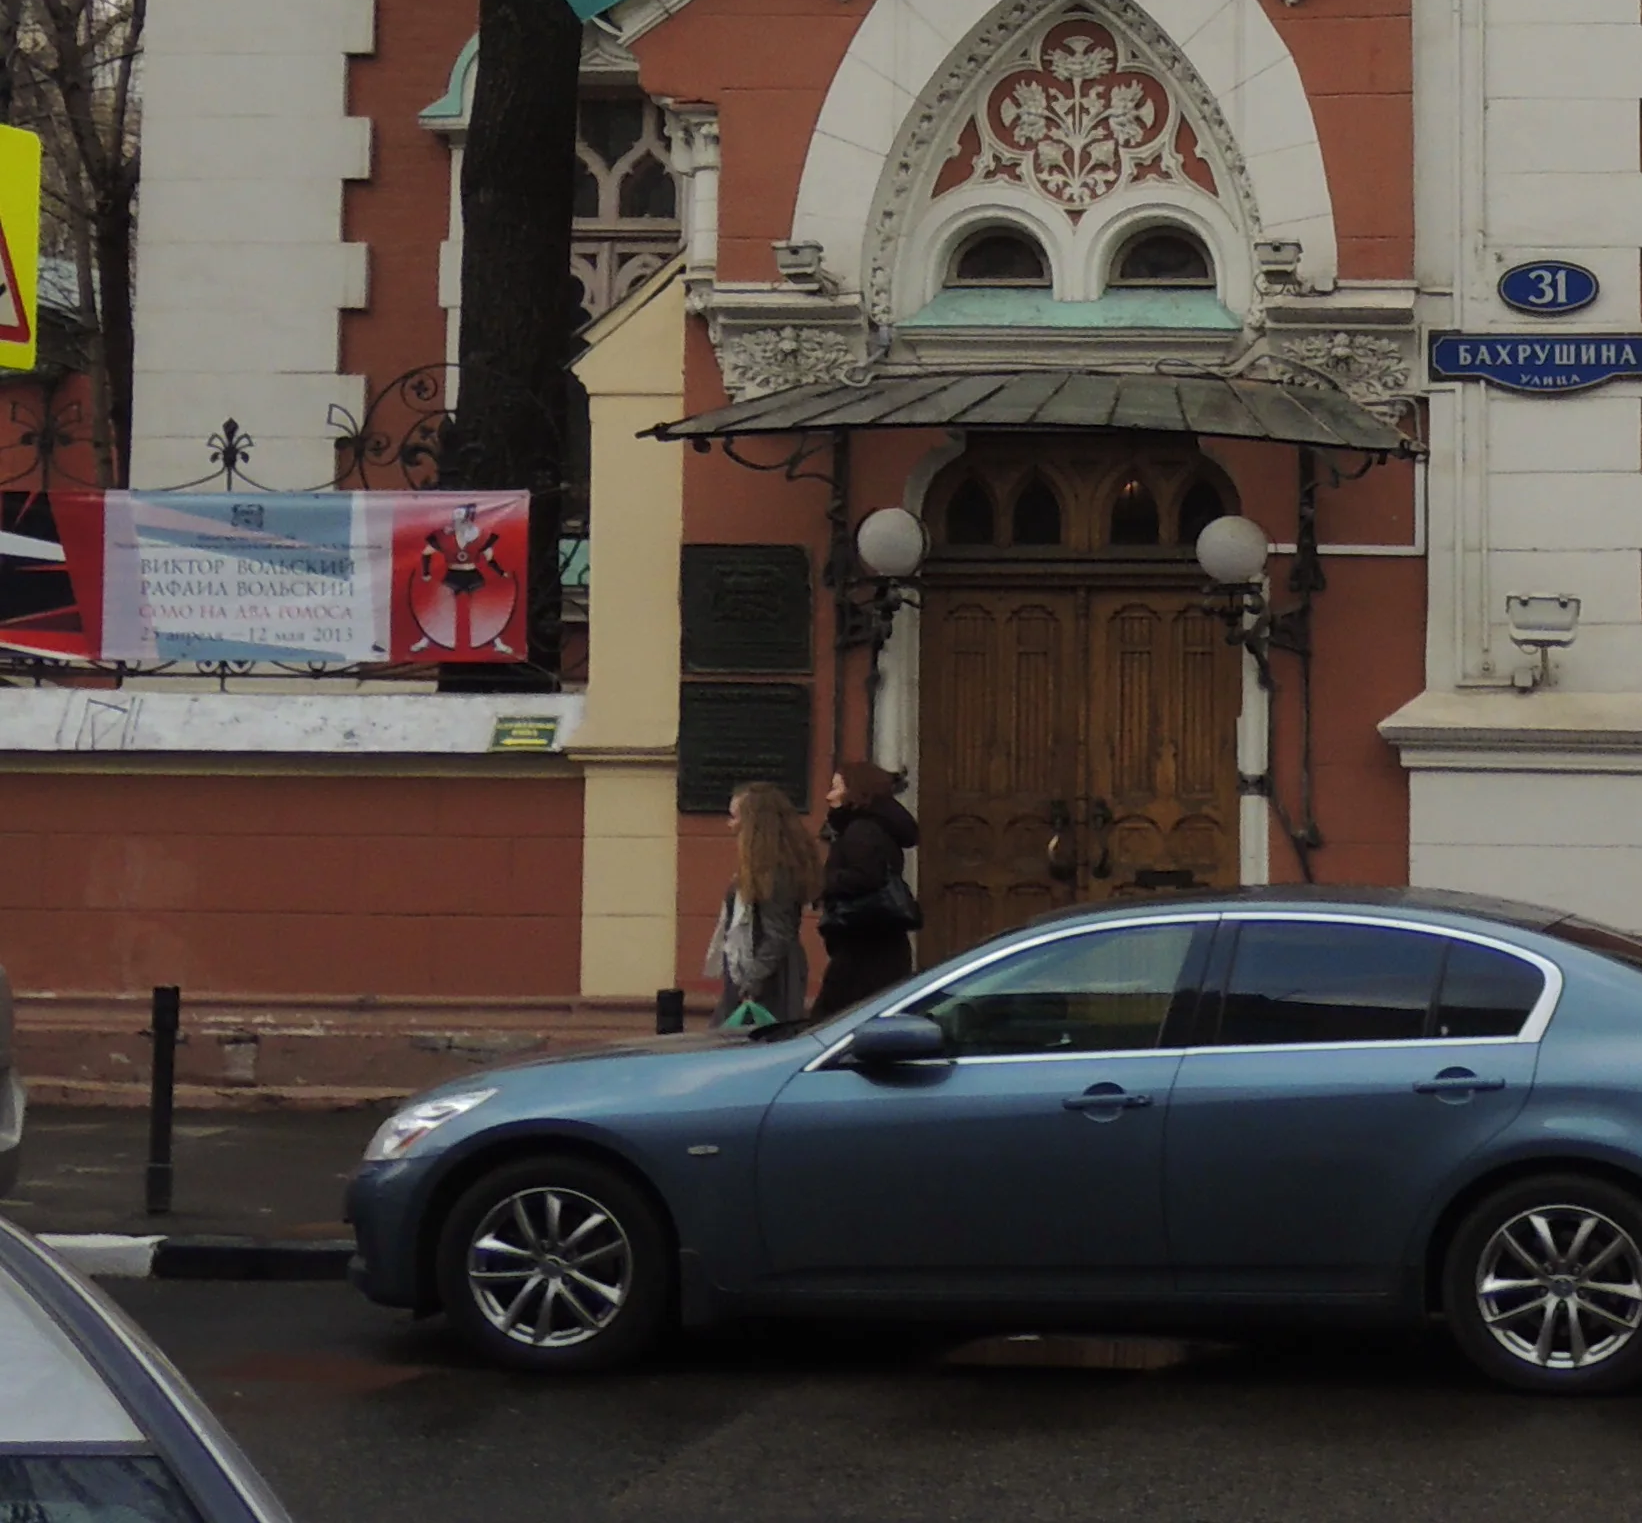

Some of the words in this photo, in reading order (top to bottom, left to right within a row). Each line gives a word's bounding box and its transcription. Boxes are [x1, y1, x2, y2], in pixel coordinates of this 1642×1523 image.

[1528, 269, 1568, 304] 31
[1458, 344, 1637, 366] БАХРУШИНА
[1519, 373, 1581, 386] УЛИЦА
[140, 558, 224, 575] ВИКТОР
[236, 557, 355, 575] ВОЛЬСКИЙ
[140, 580, 228, 596] РАФАИЛ
[236, 578, 354, 596] ВОЛЬСКИЙ
[200, 605, 227, 619] НА
[313, 626, 353, 643] 2013
